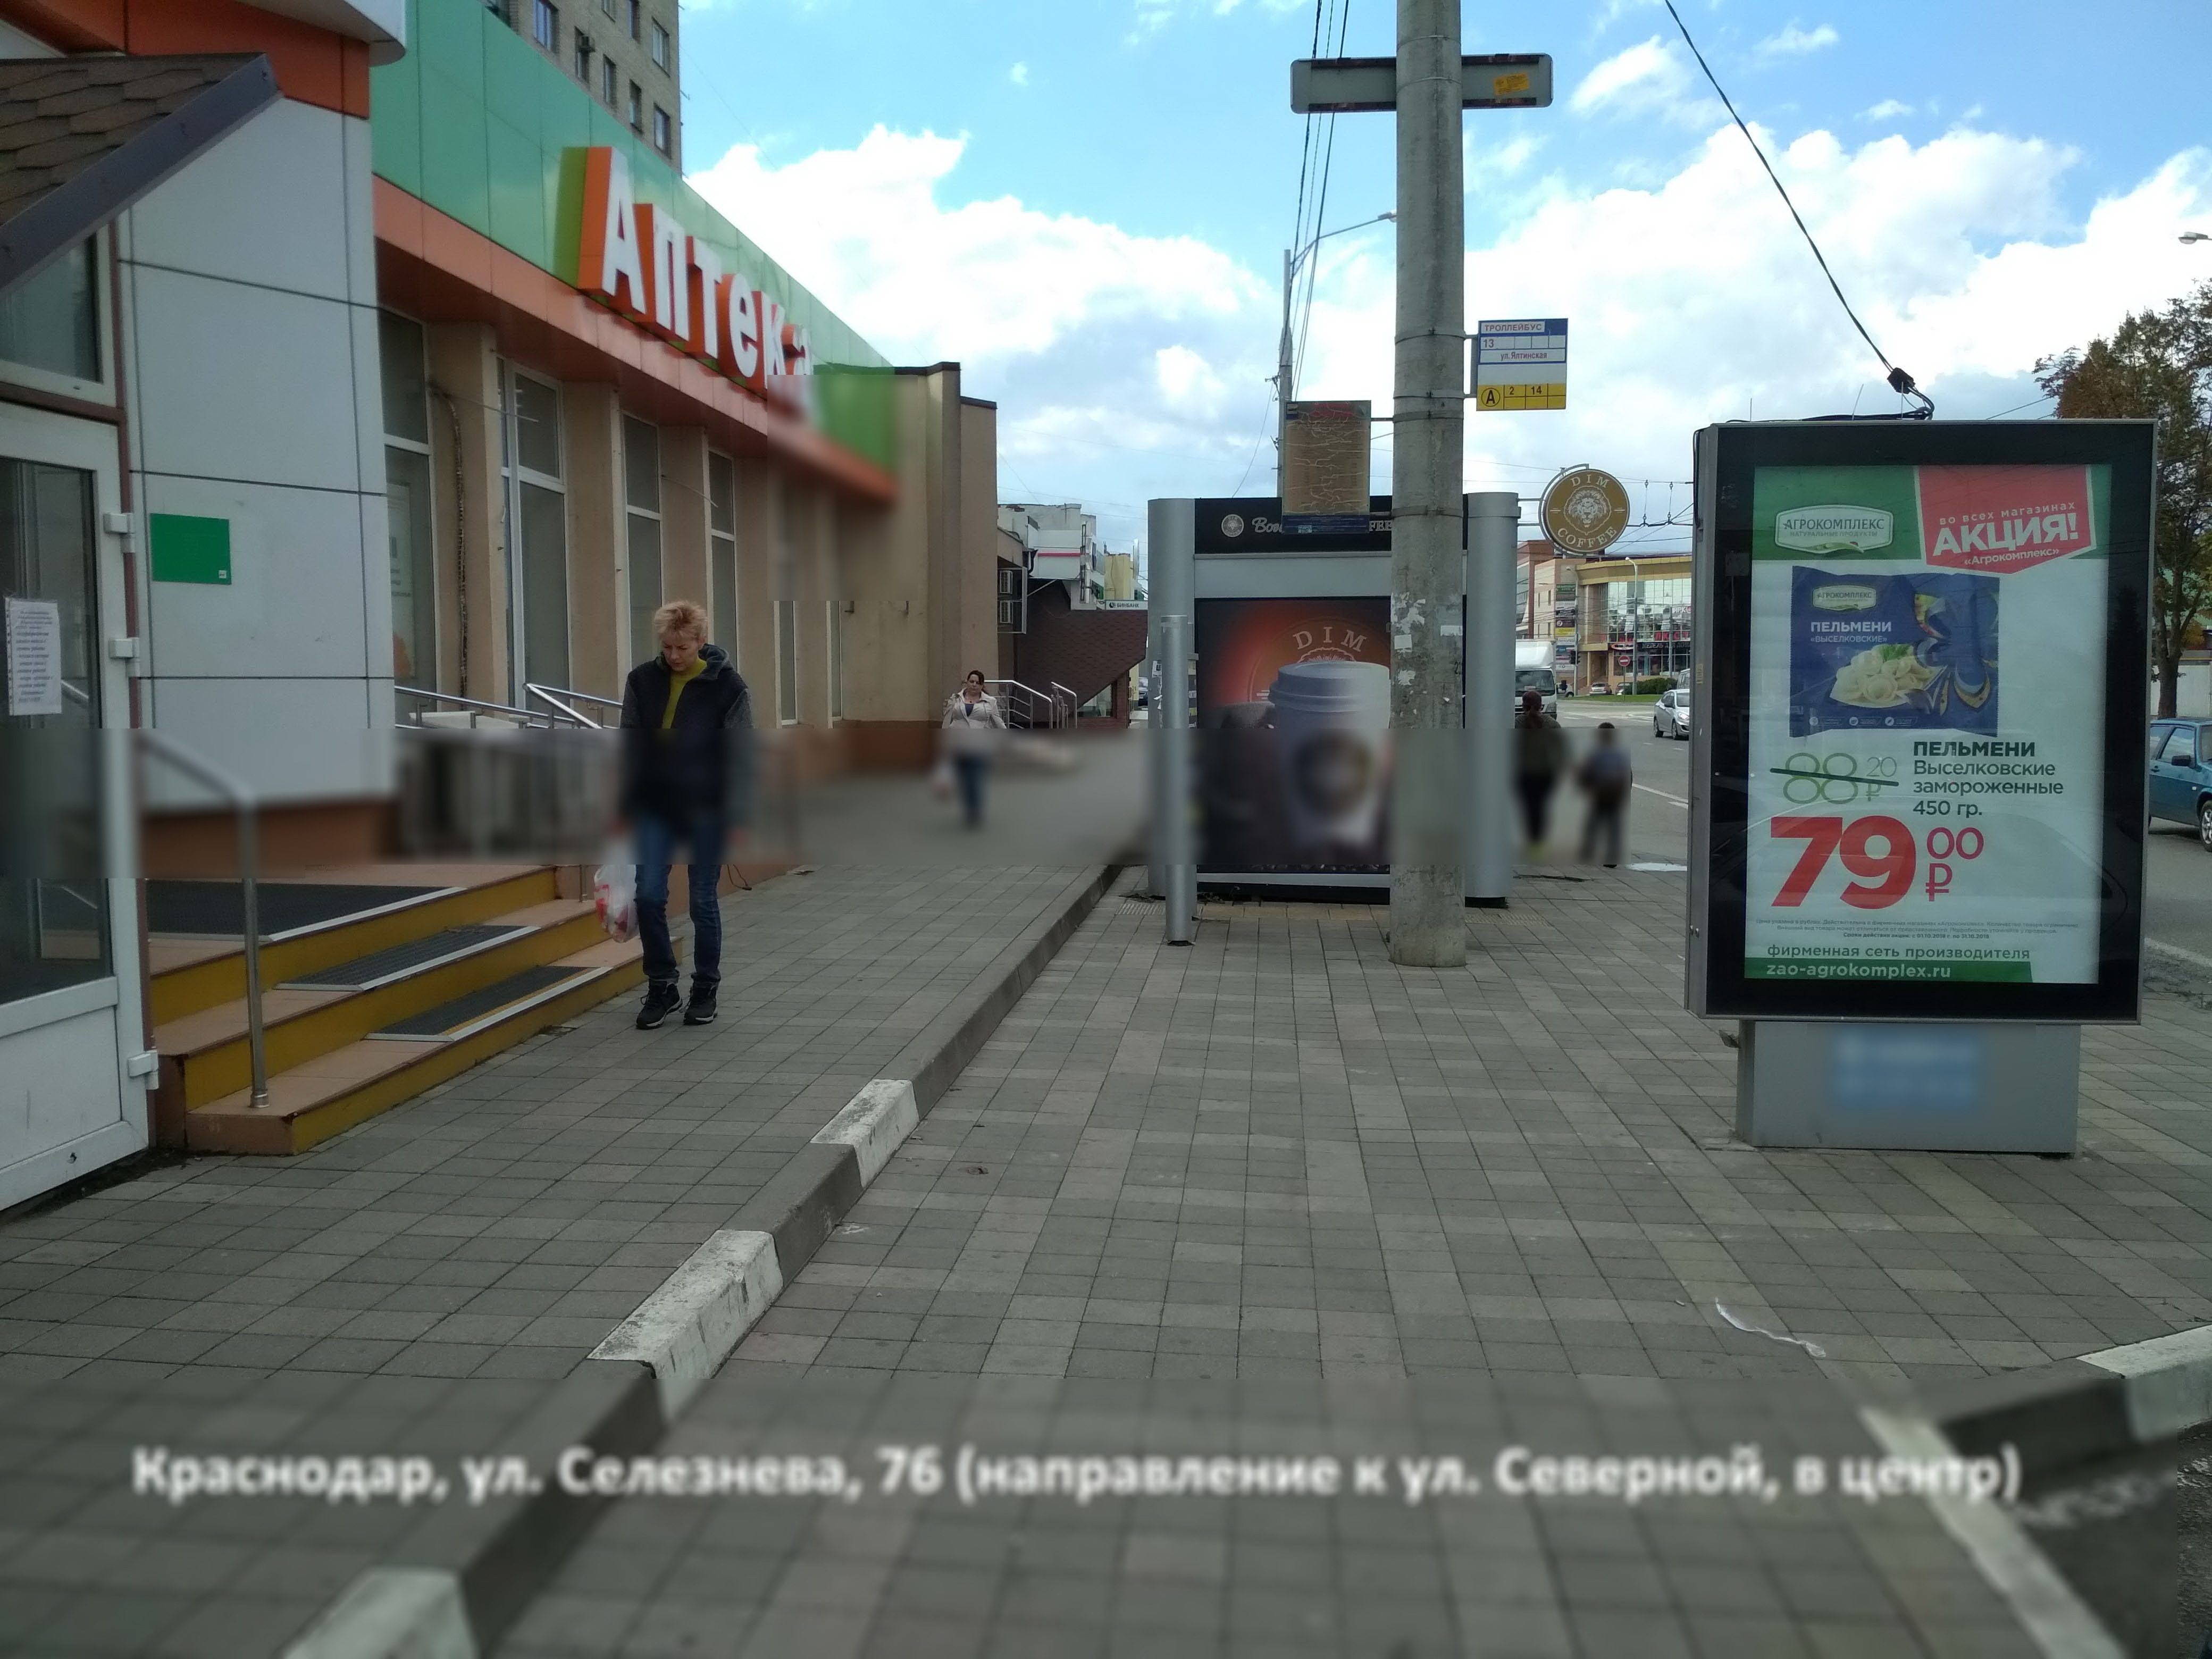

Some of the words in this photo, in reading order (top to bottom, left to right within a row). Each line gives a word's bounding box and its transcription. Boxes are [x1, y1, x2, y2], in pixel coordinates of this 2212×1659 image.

[1485, 323, 1541, 332] ТРОЛЛЕЙБУС
[1484, 339, 1494, 348] 13
[1509, 387, 1514, 395] 2
[1531, 386, 1541, 395] 14
[1571, 474, 1609, 489] DIM
[1940, 516, 1956, 525] во
[1963, 512, 1993, 522] всех
[2001, 502, 2075, 517] магазинах
[1783, 518, 1884, 530] АГРОКОМПЛЕКС
[1557, 526, 1618, 548] COFFEE
[1933, 513, 2079, 556] АКЦИЯ!
[1965, 548, 2059, 565] «Агрокомплекс»
[1811, 621, 1892, 632] ПЕЛЬМЕНИ
[1293, 626, 1367, 652] DIM
[1914, 741, 2035, 757] ПЕЛЬМЕНИ
[1914, 760, 2056, 776] Выселковские
[1783, 752, 1858, 804] 88
[1866, 757, 1897, 777] 20
[1914, 781, 2063, 795] замороженные
[1913, 801, 1950, 816] 450
[1957, 803, 1982, 819] гр.
[1771, 815, 1916, 910] 79
[1926, 827, 1984, 860] 00
[1767, 944, 1859, 958] фирменная
[1865, 948, 1899, 957] сеть
[1906, 949, 2030, 959] производителя
[1767, 963, 1950, 979] zao-agrokomplex.ru
